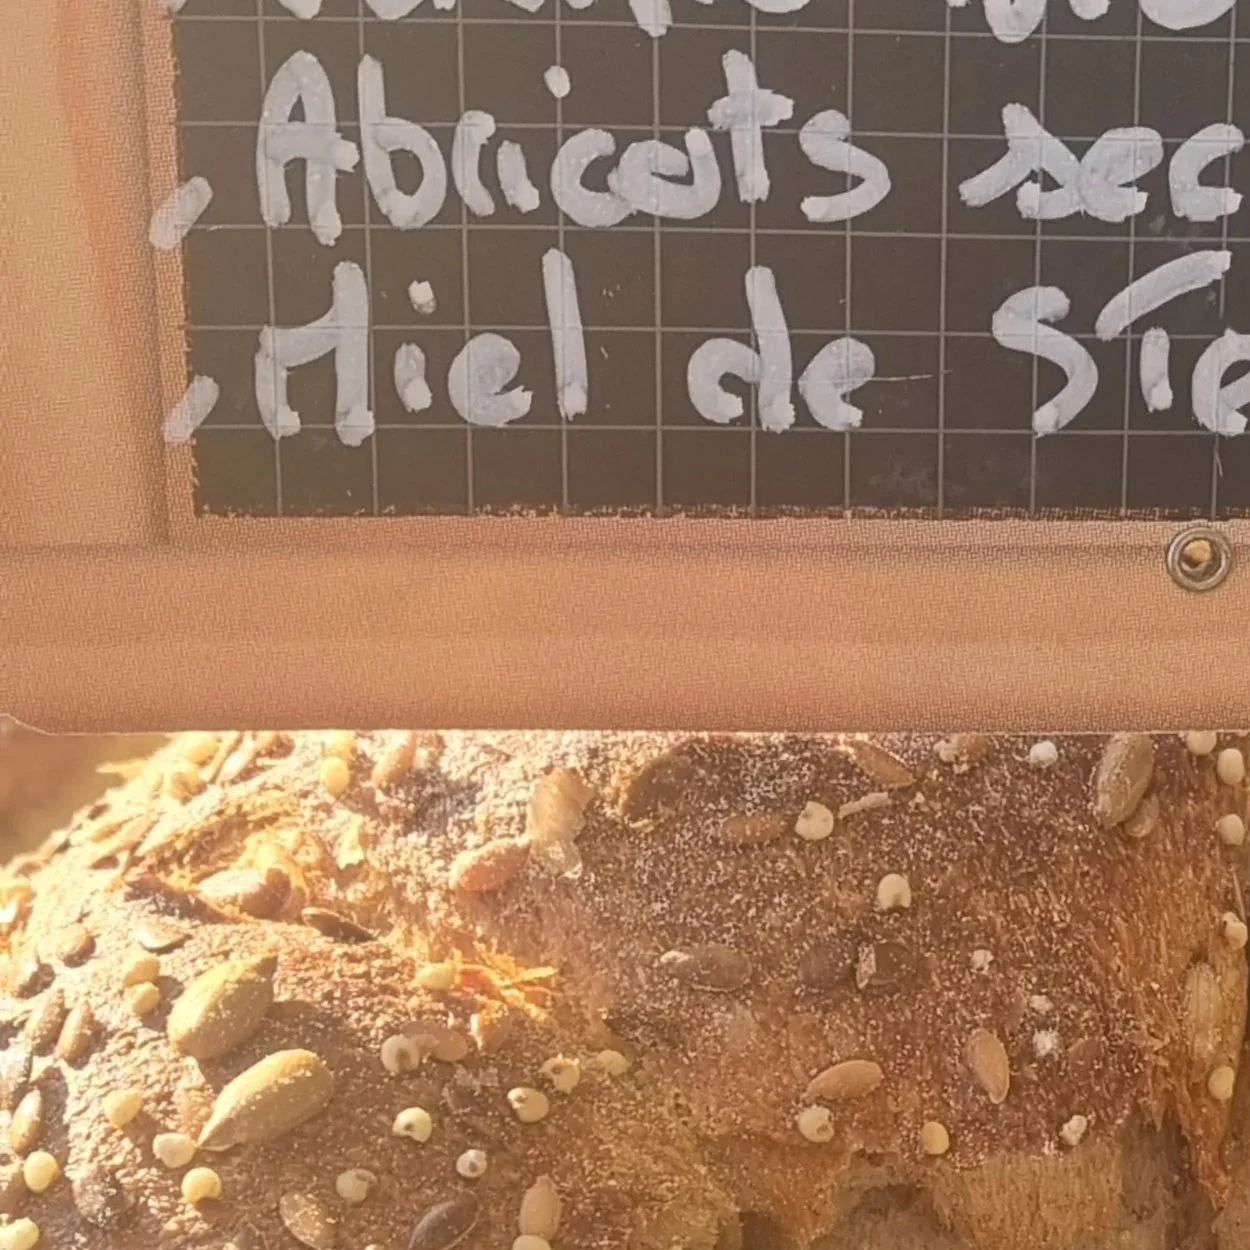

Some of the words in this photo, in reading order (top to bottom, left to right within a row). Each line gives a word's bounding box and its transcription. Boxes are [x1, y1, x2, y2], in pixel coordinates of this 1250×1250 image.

[256, 49, 891, 245] Abricots
[254, 248, 588, 446] Miel
[687, 265, 876, 433] de
